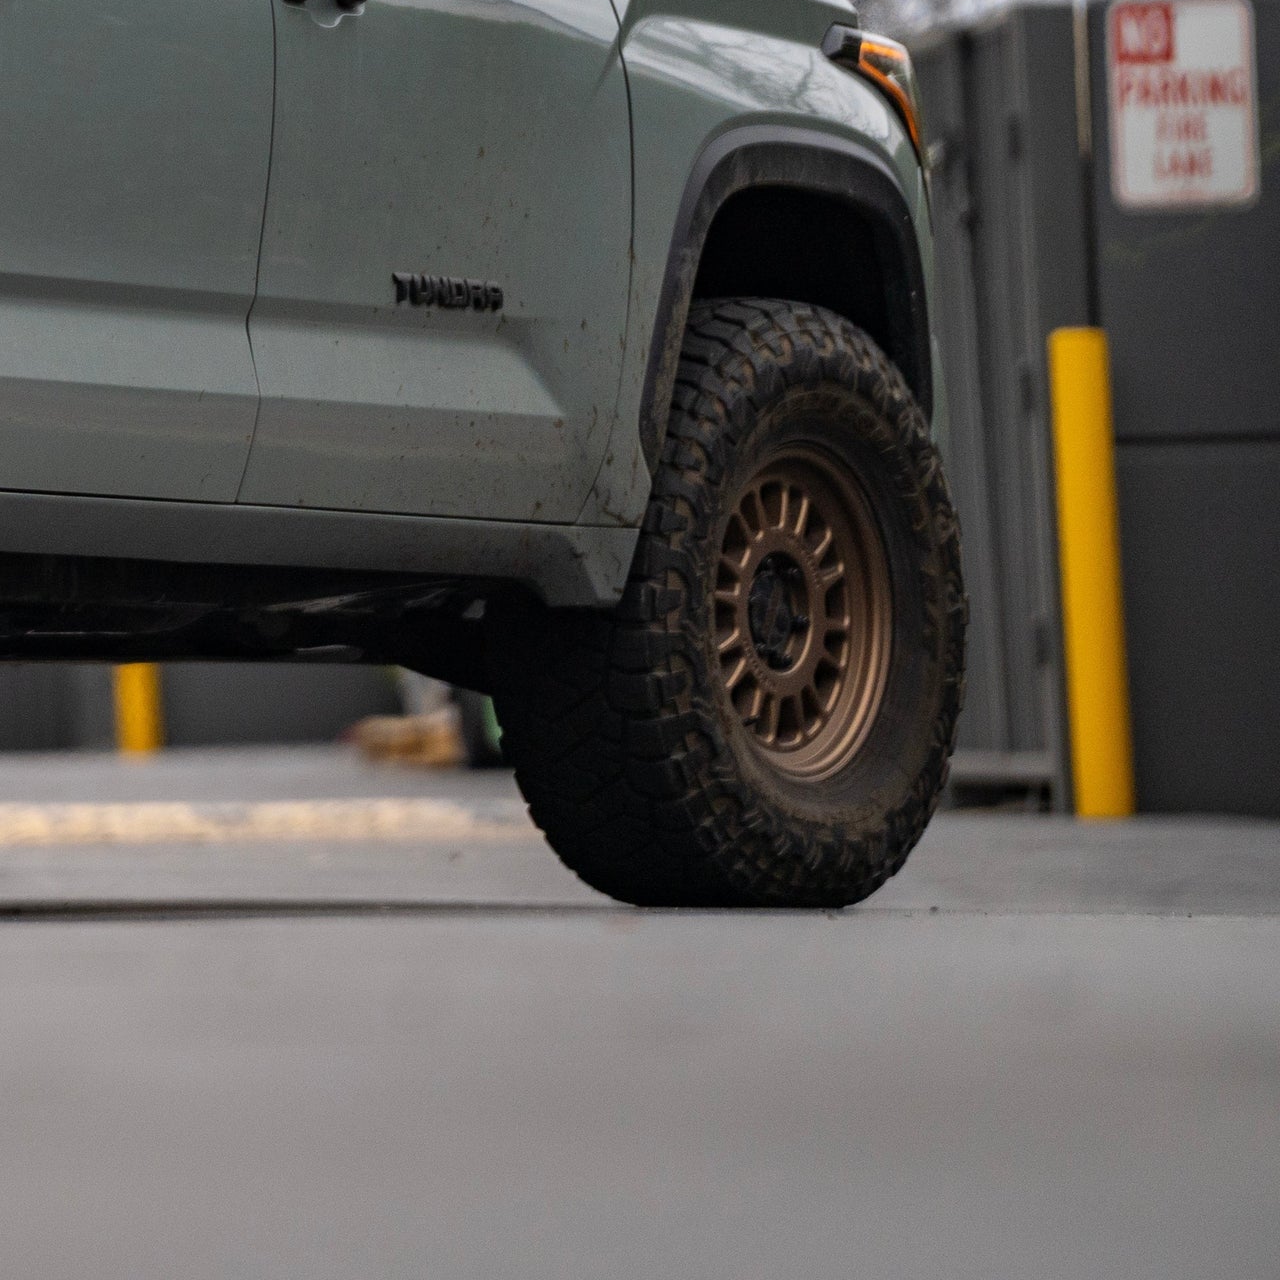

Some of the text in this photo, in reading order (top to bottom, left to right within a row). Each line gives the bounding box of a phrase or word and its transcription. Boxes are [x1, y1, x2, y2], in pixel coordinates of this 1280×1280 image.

[1120, 15, 1165, 55] NO
[1118, 70, 1248, 106] PARKING
[392, 272, 504, 311] TUNDRA
